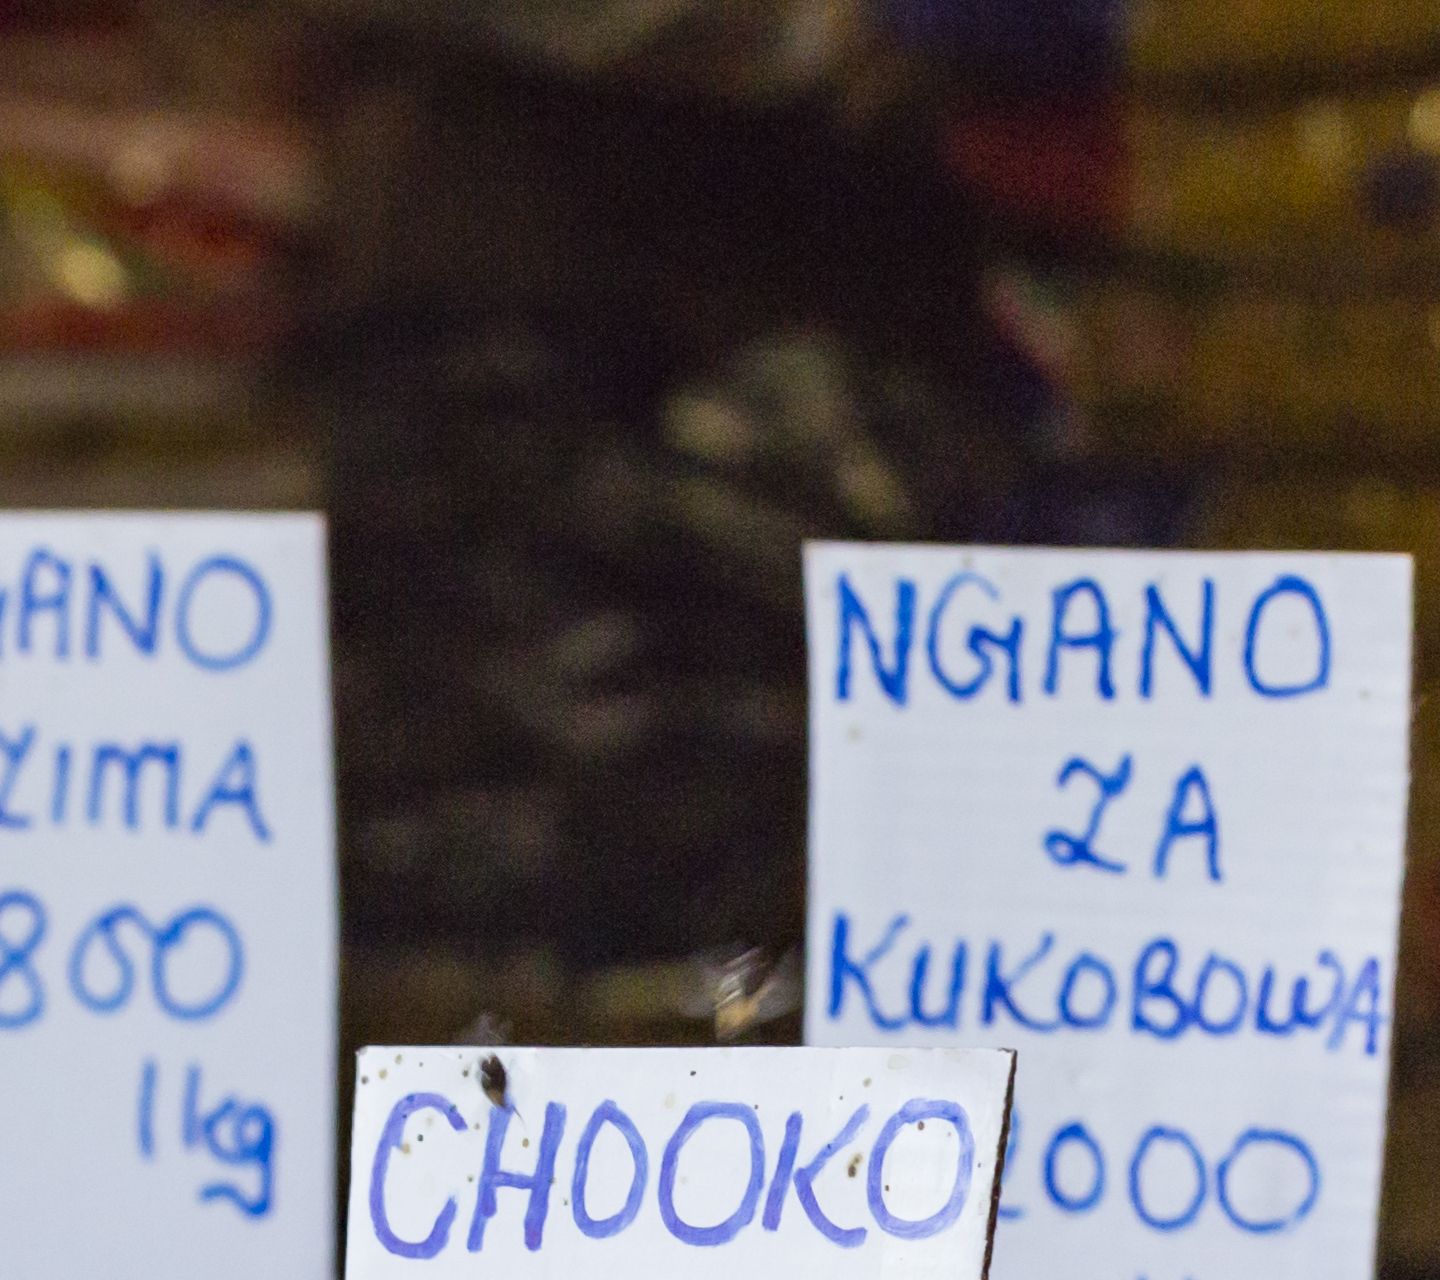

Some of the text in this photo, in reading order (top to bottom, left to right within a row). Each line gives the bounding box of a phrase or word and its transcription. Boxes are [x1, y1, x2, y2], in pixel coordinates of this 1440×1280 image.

[833, 570, 1331, 708] NGANO
[1041, 753, 1224, 881] ZA
[826, 910, 1382, 1056] KUKOBOWA
[136, 1056, 274, 1217] 1kg
[369, 1090, 976, 1260] CHOOKO
